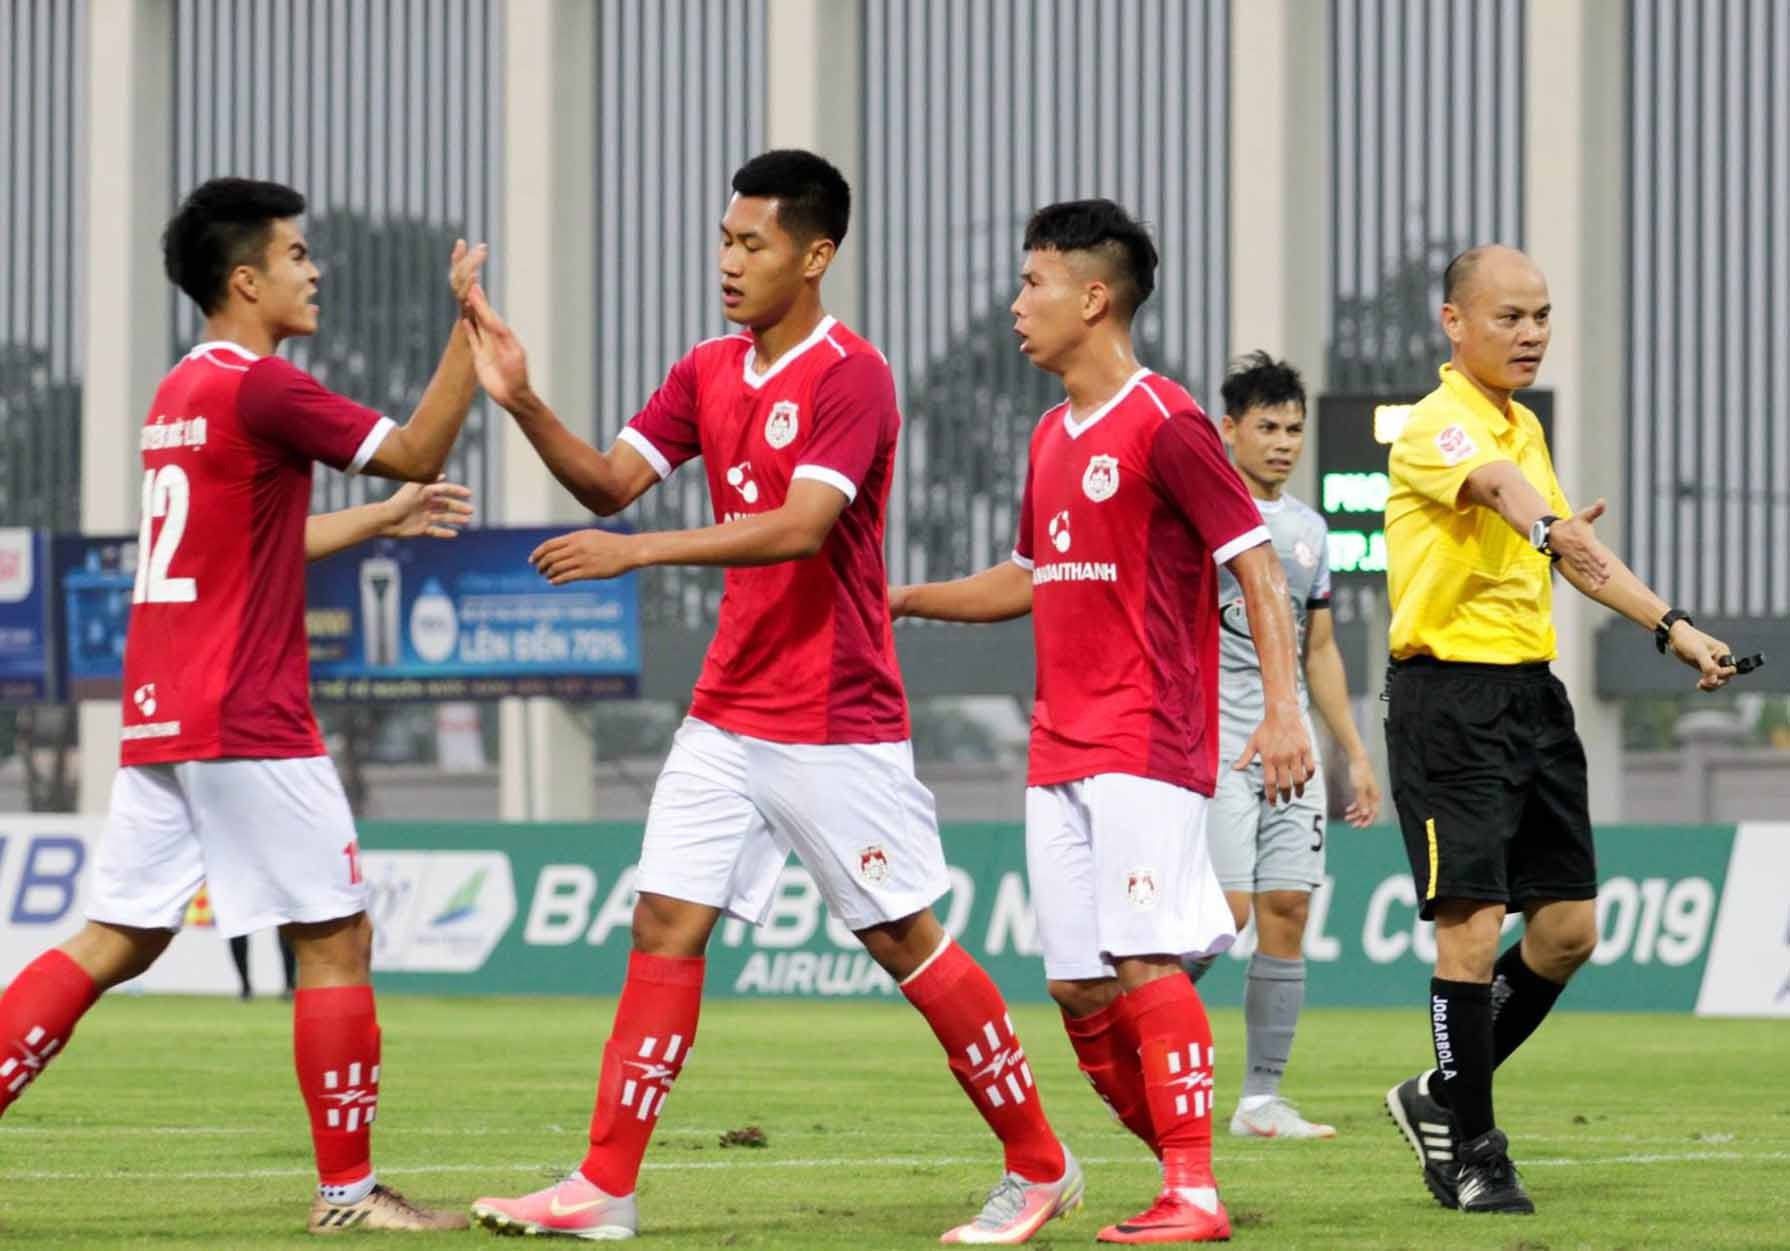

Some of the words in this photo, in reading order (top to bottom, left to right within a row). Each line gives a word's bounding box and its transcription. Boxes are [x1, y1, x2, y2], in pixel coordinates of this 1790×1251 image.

[132, 464, 198, 605] 12
[1310, 814, 1324, 852] 5
[0, 836, 86, 924] B
[1589, 876, 1715, 966] 019
[733, 951, 897, 995] AIRWA
[1432, 994, 1458, 1081] JOGARBOLA
